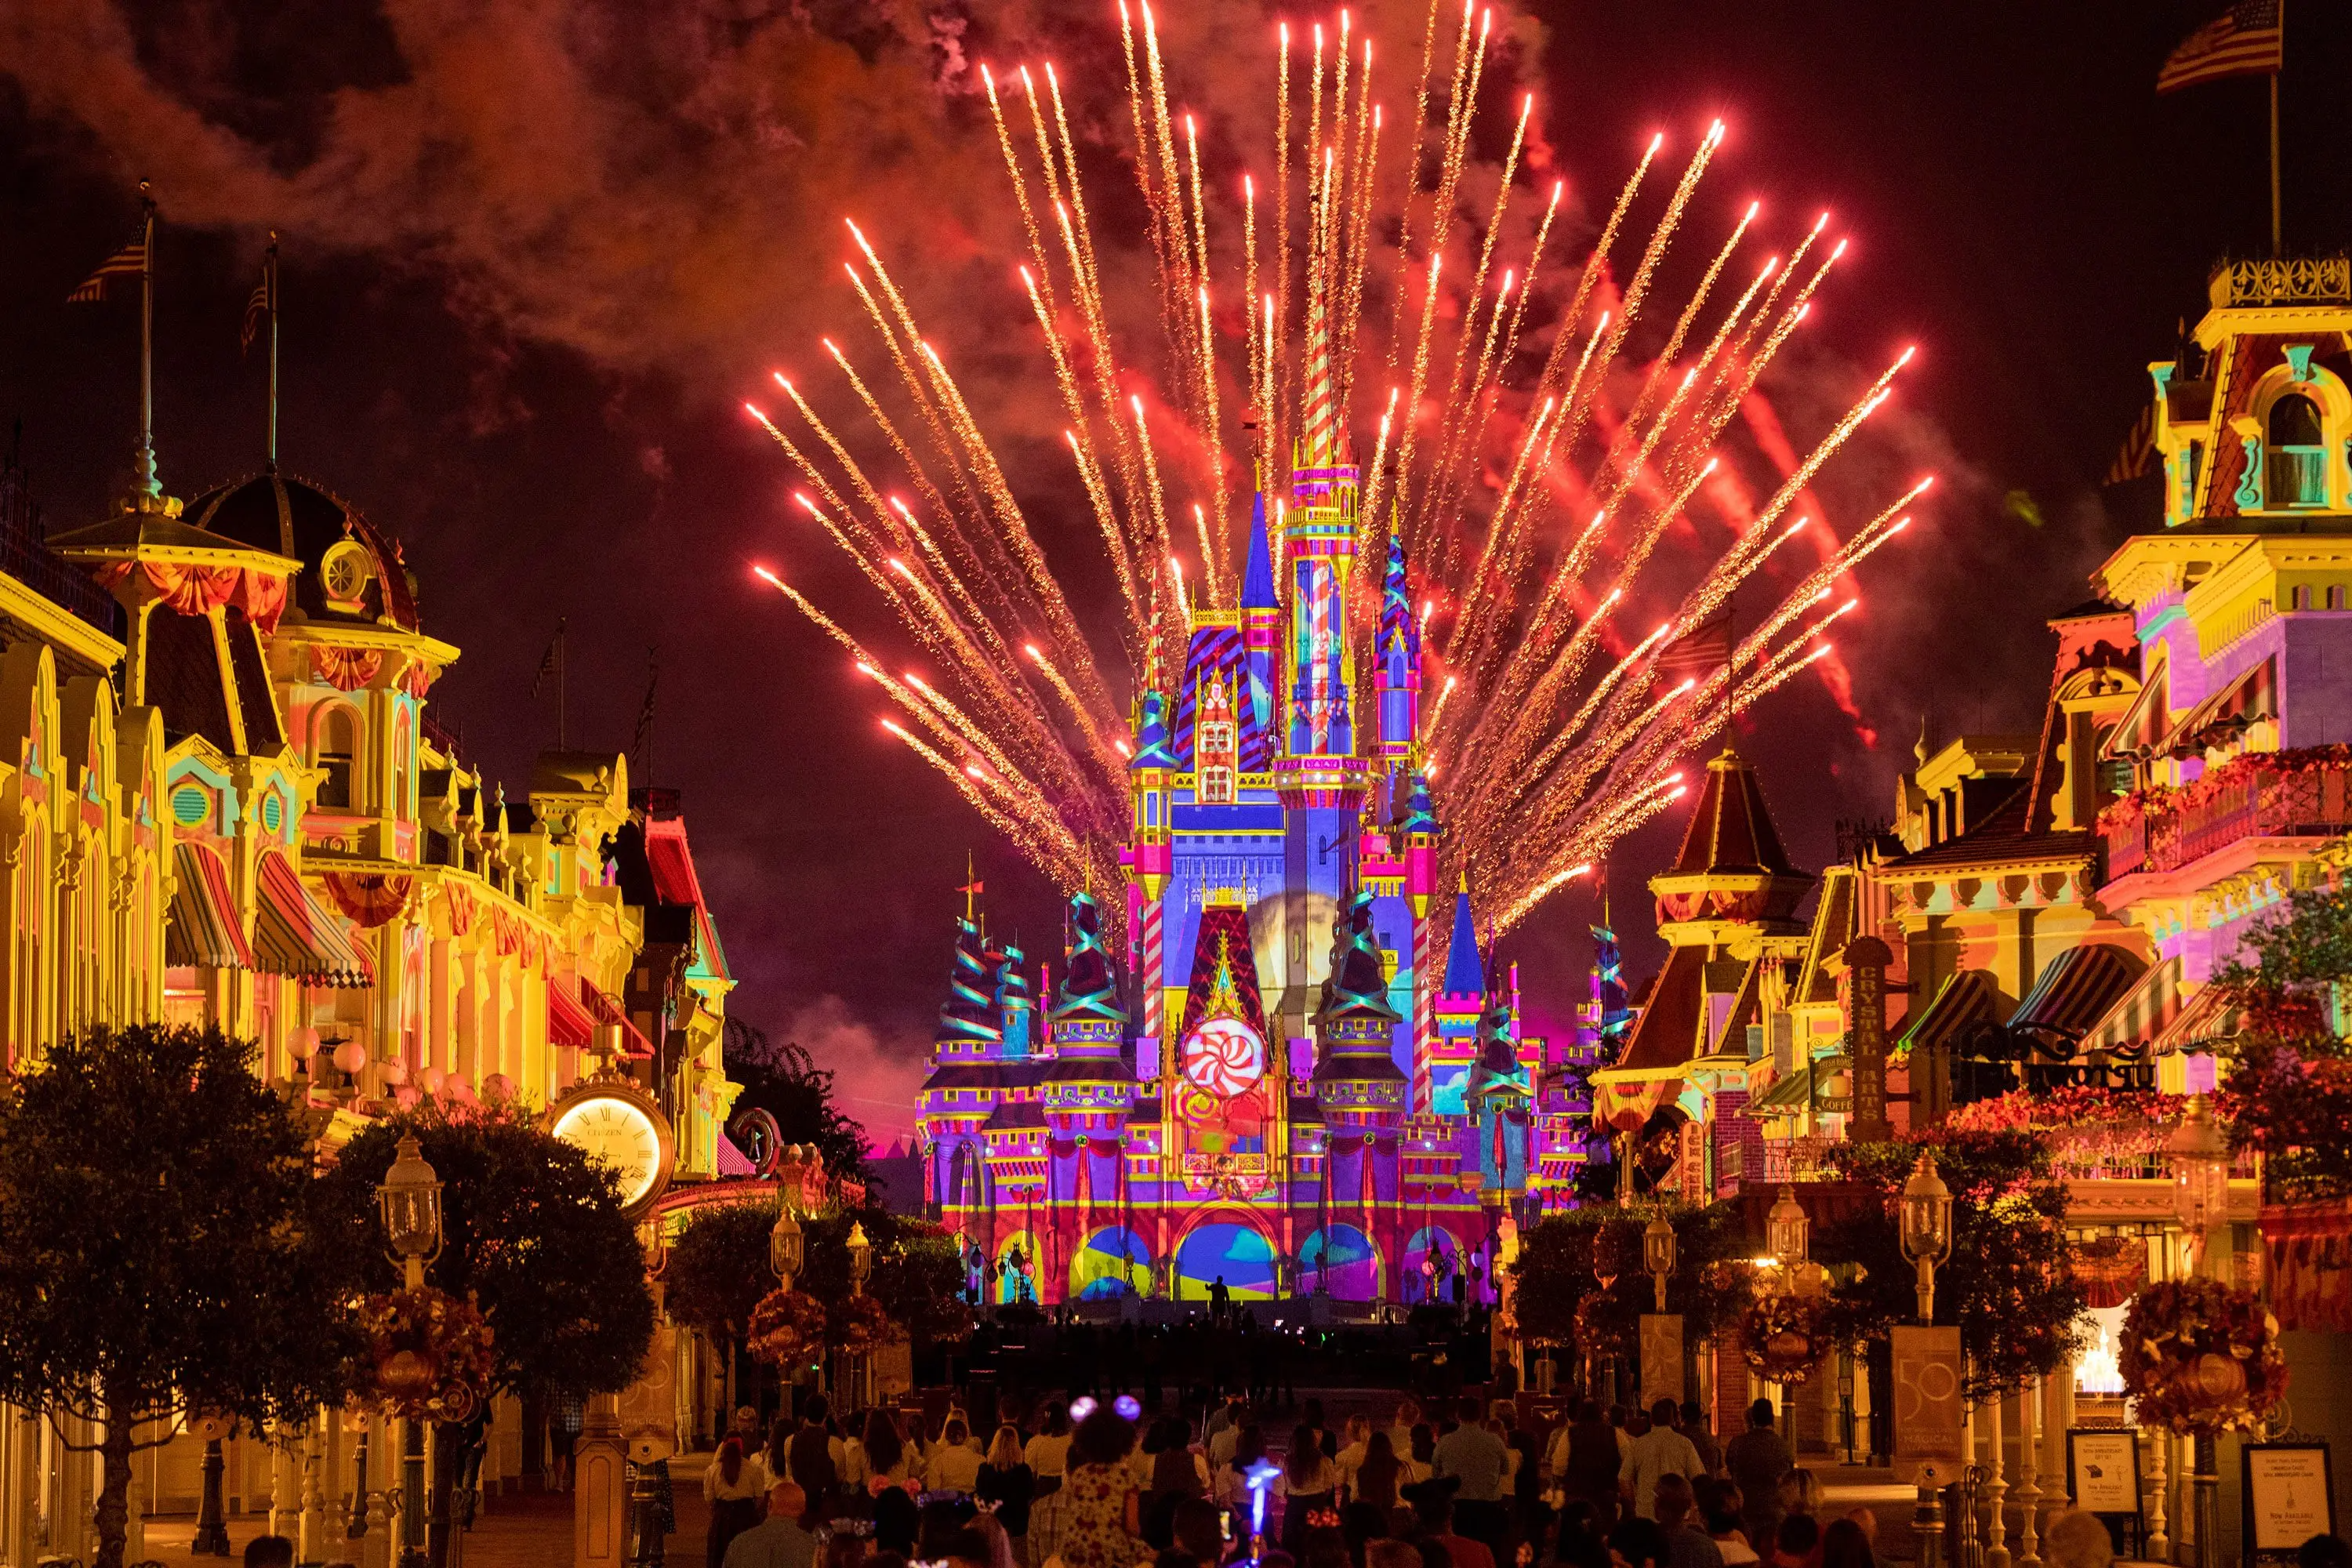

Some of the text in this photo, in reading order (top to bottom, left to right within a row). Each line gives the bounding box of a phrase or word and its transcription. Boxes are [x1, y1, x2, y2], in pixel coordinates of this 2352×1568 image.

[1860, 967, 1878, 1120] CRYSTAL ARTS
[1819, 1058, 1852, 1070] FRESH ROAS
[1821, 1098, 1853, 1111] COFFE
[1899, 1358, 1956, 1421] 50
[1904, 1435, 1954, 1443] MAGICAL
